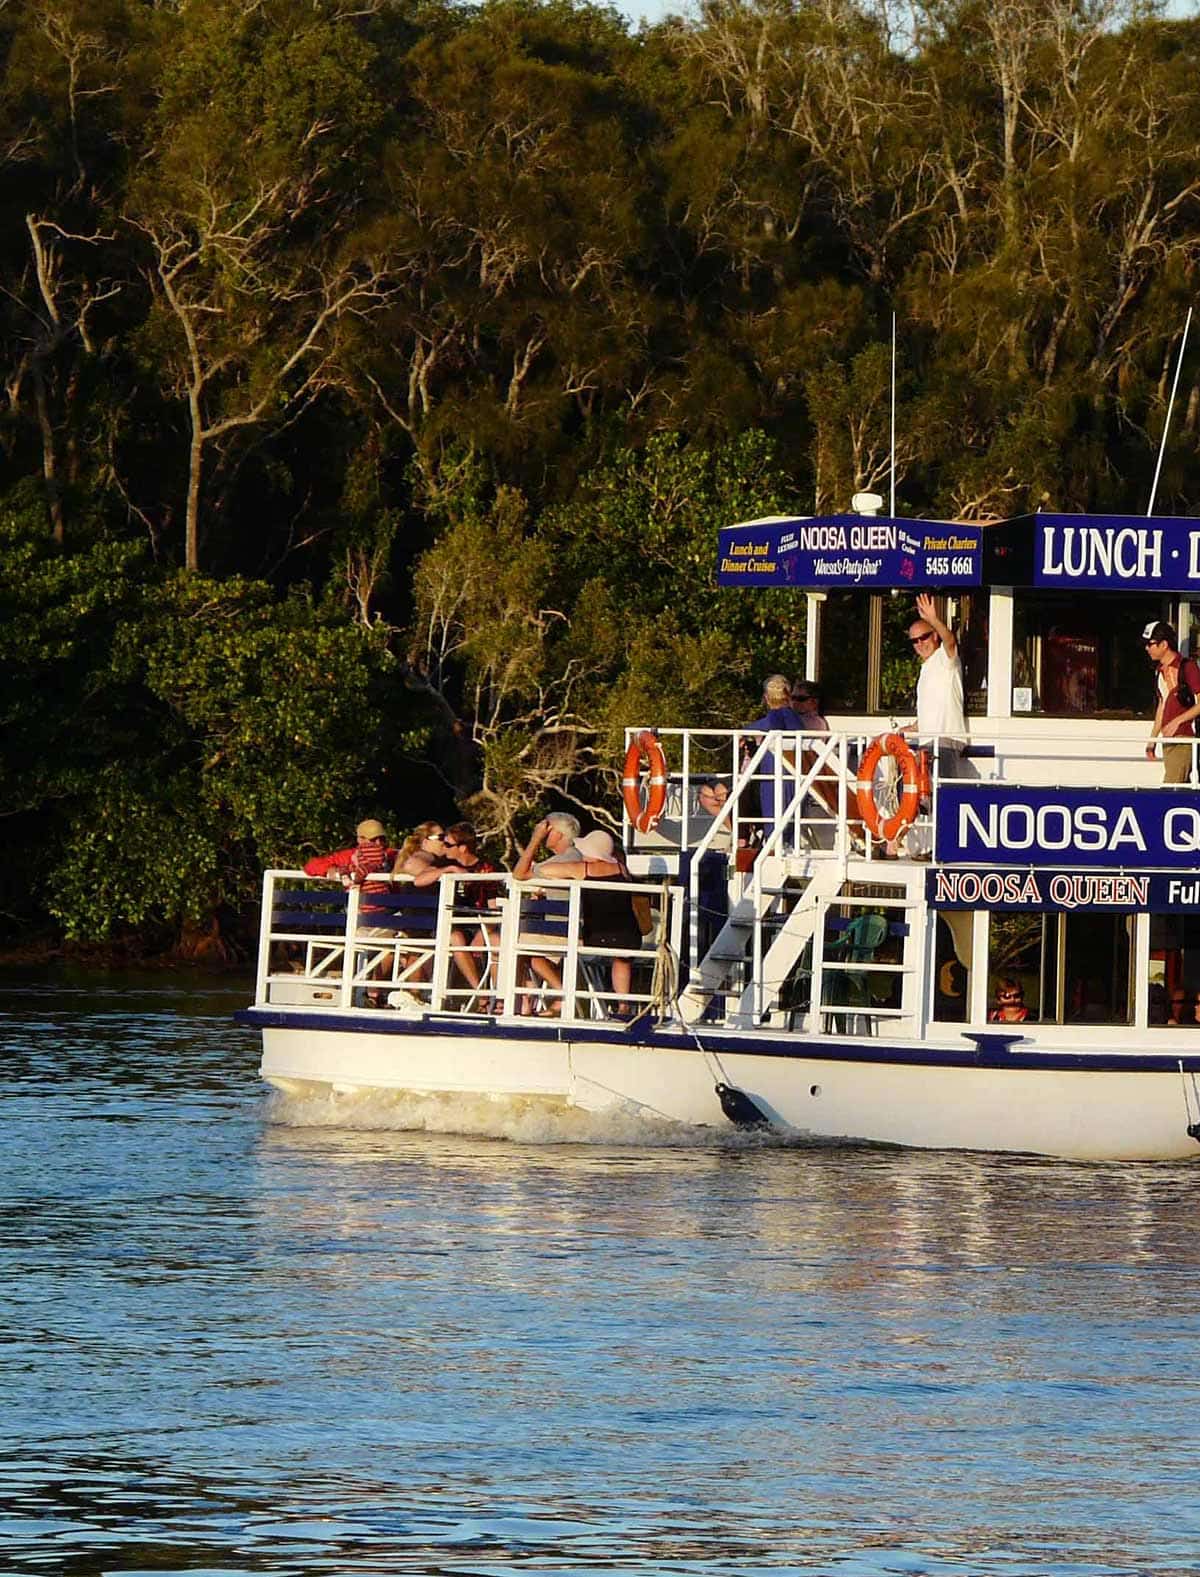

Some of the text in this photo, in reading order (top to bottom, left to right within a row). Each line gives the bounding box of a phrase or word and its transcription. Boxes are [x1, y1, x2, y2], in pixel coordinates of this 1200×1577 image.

[729, 541, 753, 555] Lunch
[753, 541, 769, 555] and
[800, 526, 847, 550] NOOSA
[850, 526, 896, 550] QUEEN
[1042, 526, 1162, 577] LUNCH
[721, 559, 747, 572] Dinner
[926, 557, 973, 575] 5455 6661
[958, 803, 1147, 851] NOOSA
[935, 873, 1042, 903] NOOSA
[1050, 875, 1150, 909] QUEEN
